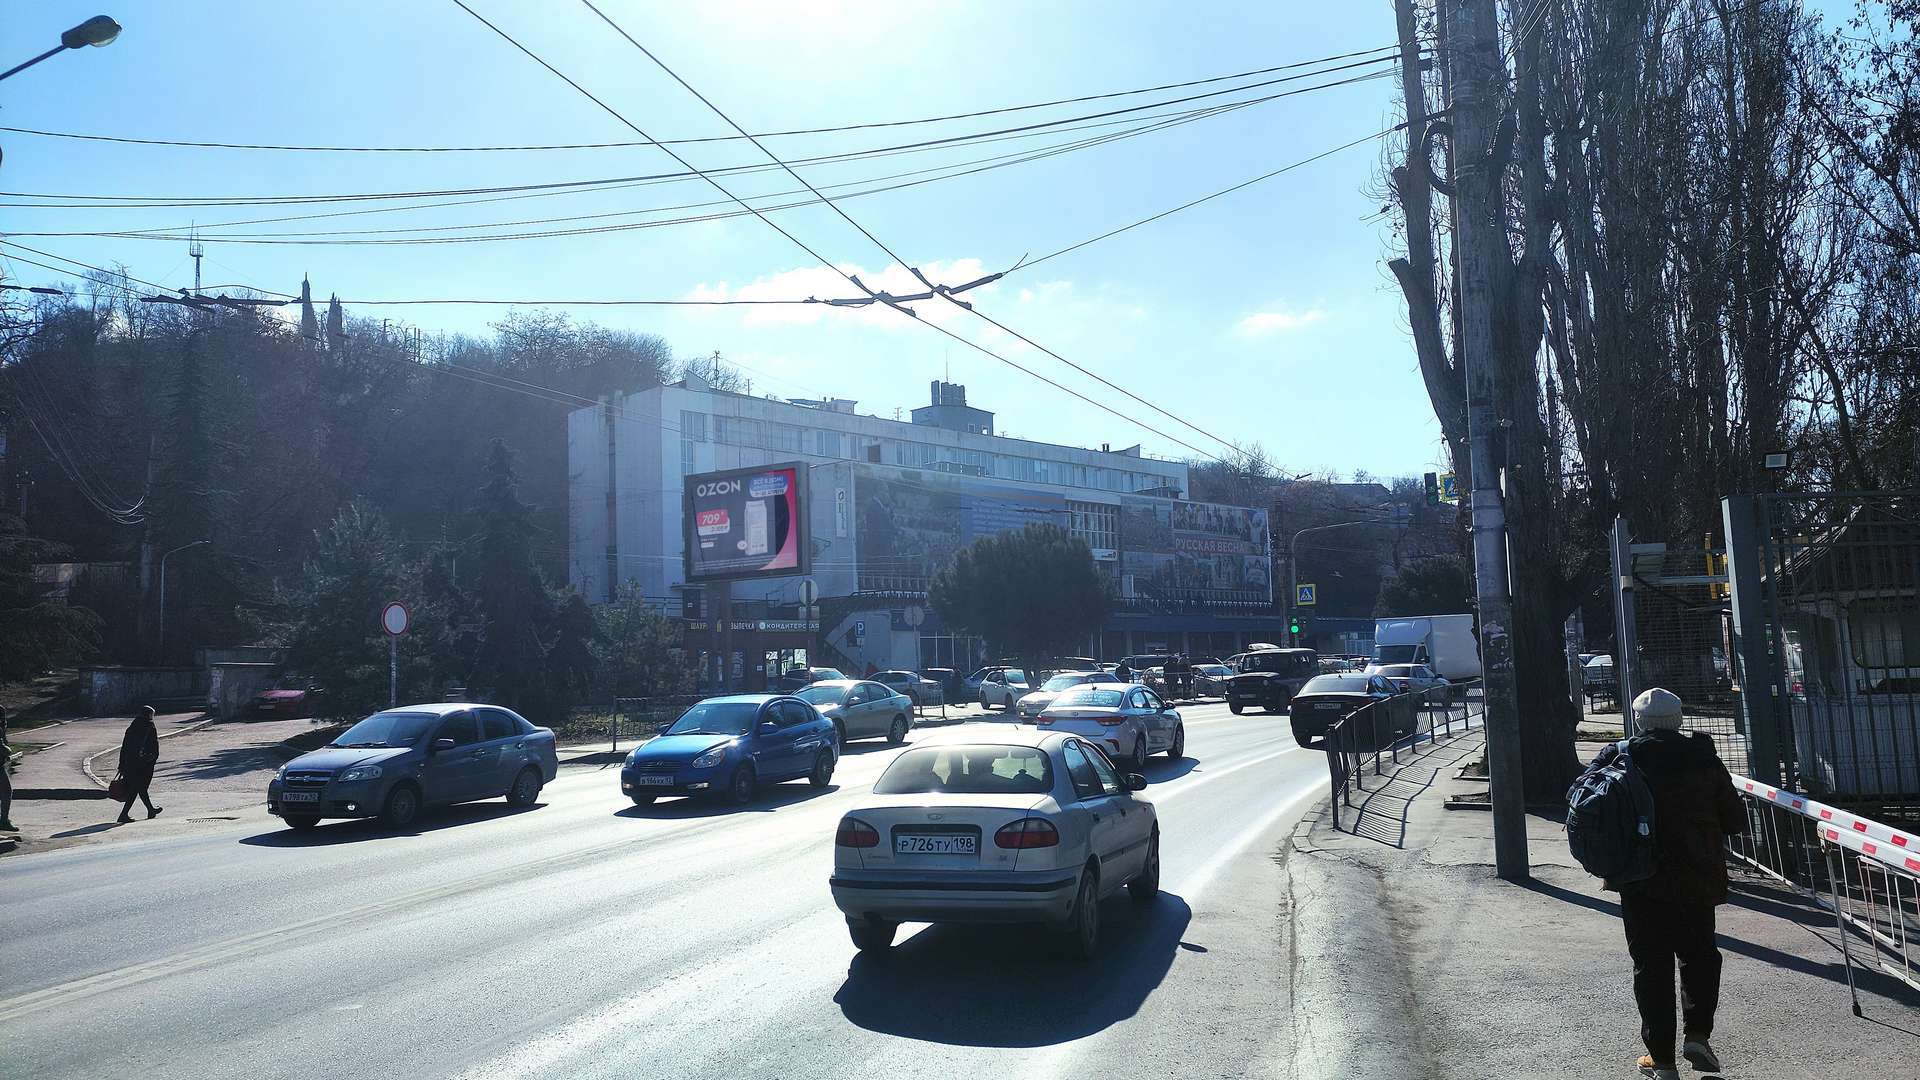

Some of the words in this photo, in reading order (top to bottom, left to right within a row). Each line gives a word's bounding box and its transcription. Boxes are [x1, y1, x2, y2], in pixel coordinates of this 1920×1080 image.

[697, 480, 741, 497] OZON
[702, 513, 720, 525] 709
[1175, 538, 1216, 552] РУССКАЯ
[1217, 541, 1247, 553] ВЕСНА
[901, 837, 951, 852] Р726ТУ
[953, 837, 972, 849] 198
